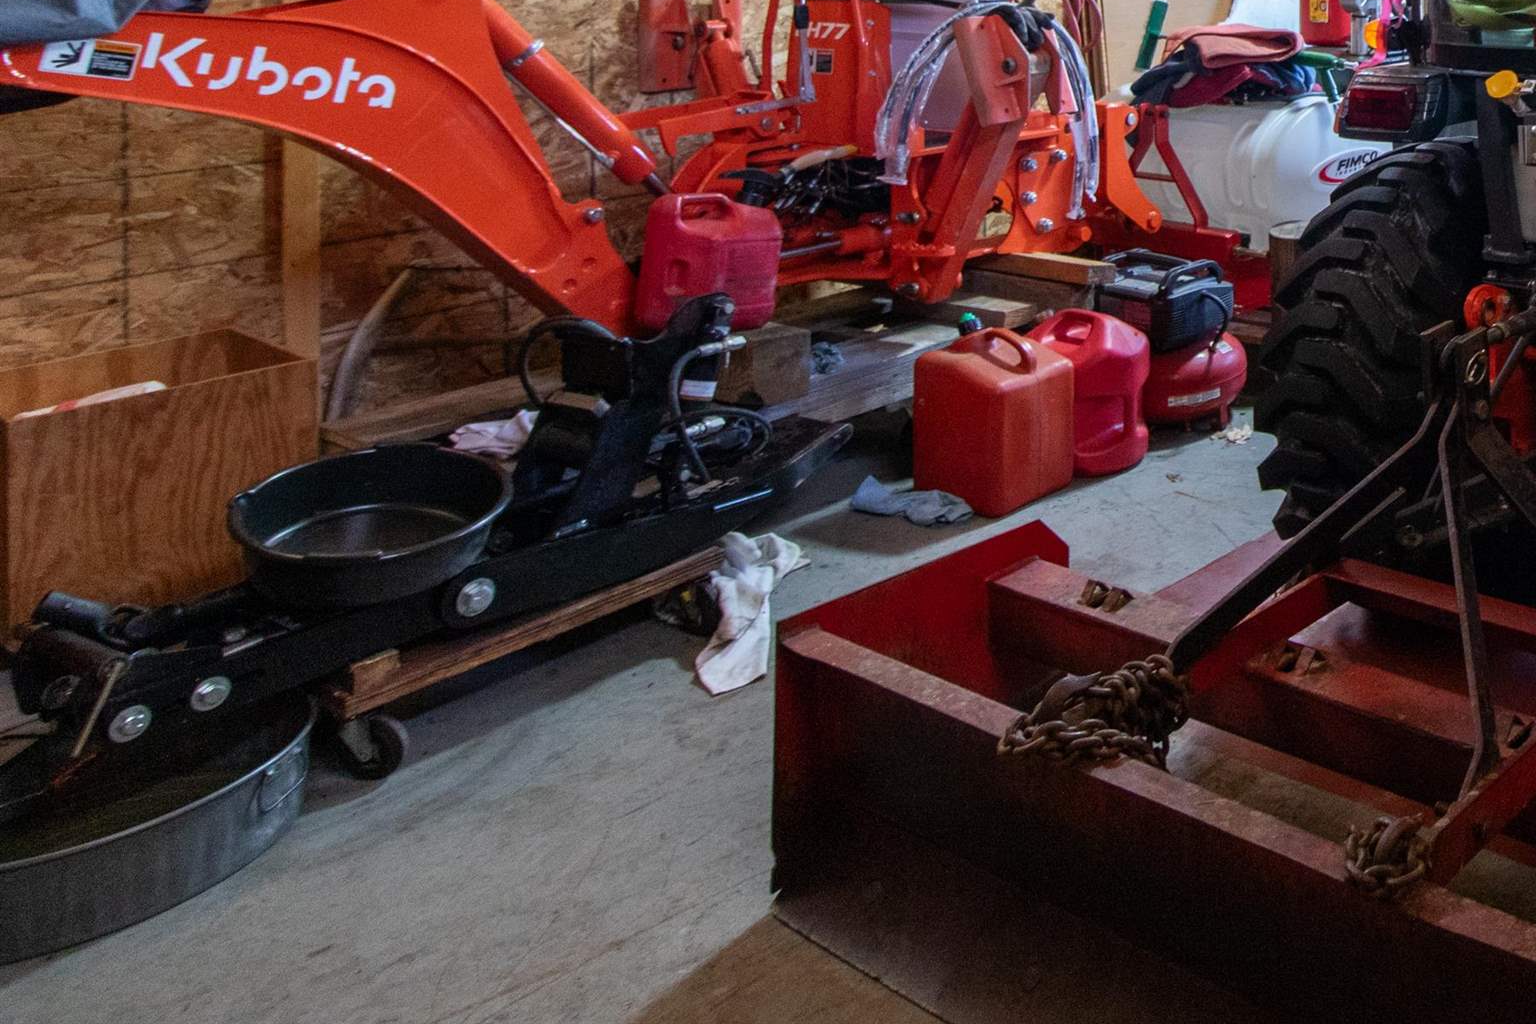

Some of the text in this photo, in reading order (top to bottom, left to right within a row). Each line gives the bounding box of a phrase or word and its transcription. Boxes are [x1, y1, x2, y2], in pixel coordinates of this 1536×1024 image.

[796, 21, 850, 40] H77
[141, 32, 396, 108] Kubota
[1336, 150, 1378, 171] FIMCO
